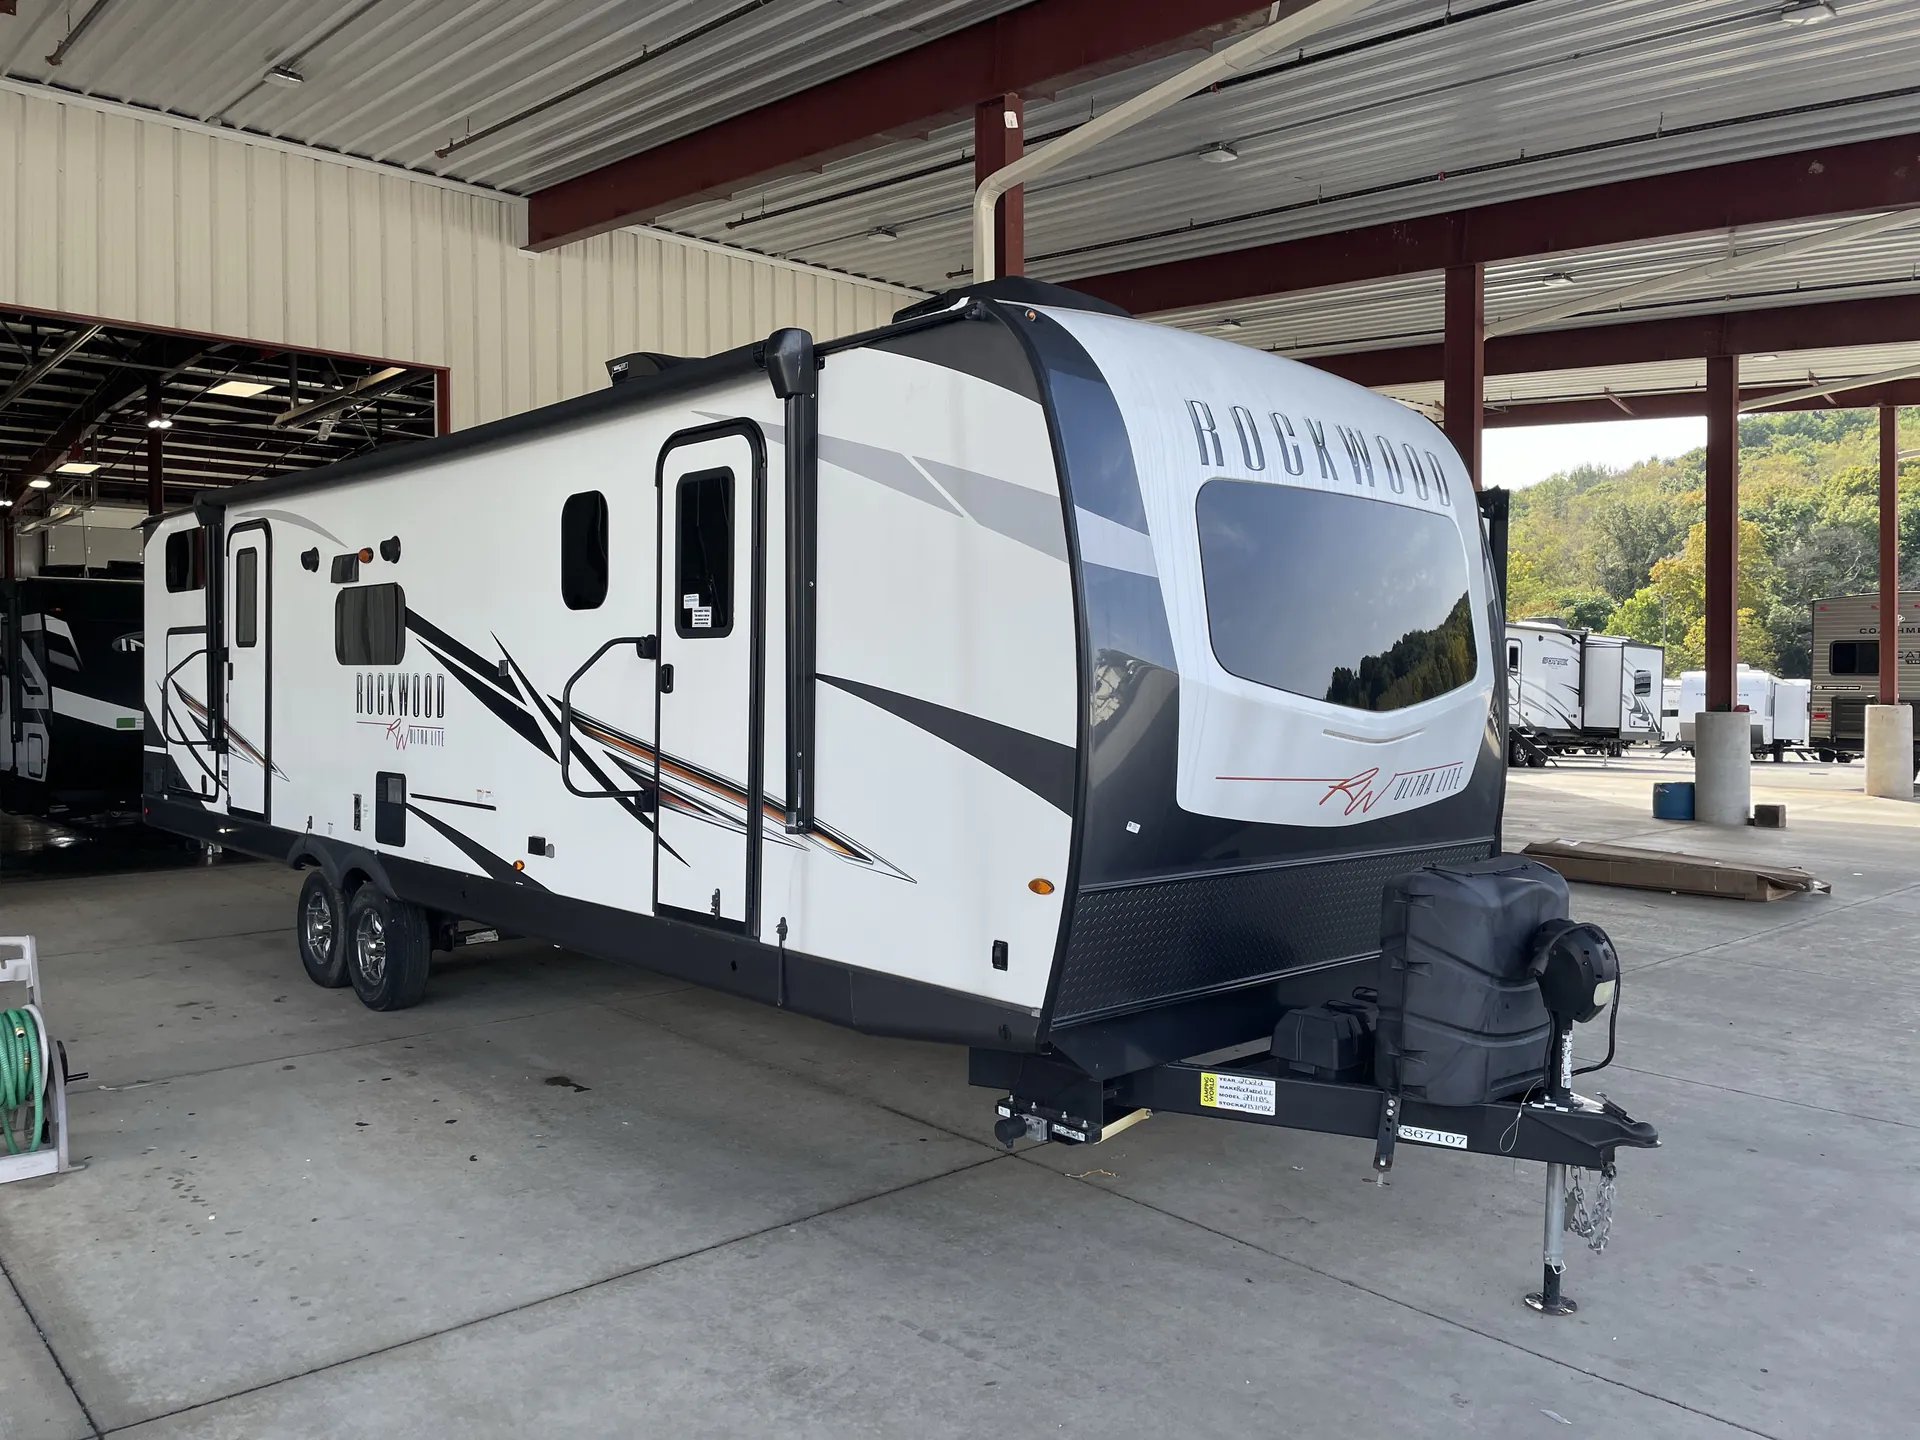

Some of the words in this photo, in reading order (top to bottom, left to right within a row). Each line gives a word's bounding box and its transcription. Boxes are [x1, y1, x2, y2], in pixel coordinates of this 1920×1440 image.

[1184, 398, 1450, 506] ROCKWOOD
[356, 672, 445, 718] ROCKWOOD
[1394, 772, 1436, 801] ULTRA
[1435, 767, 1464, 794] LITE
[1403, 1127, 1466, 1145] 867107
